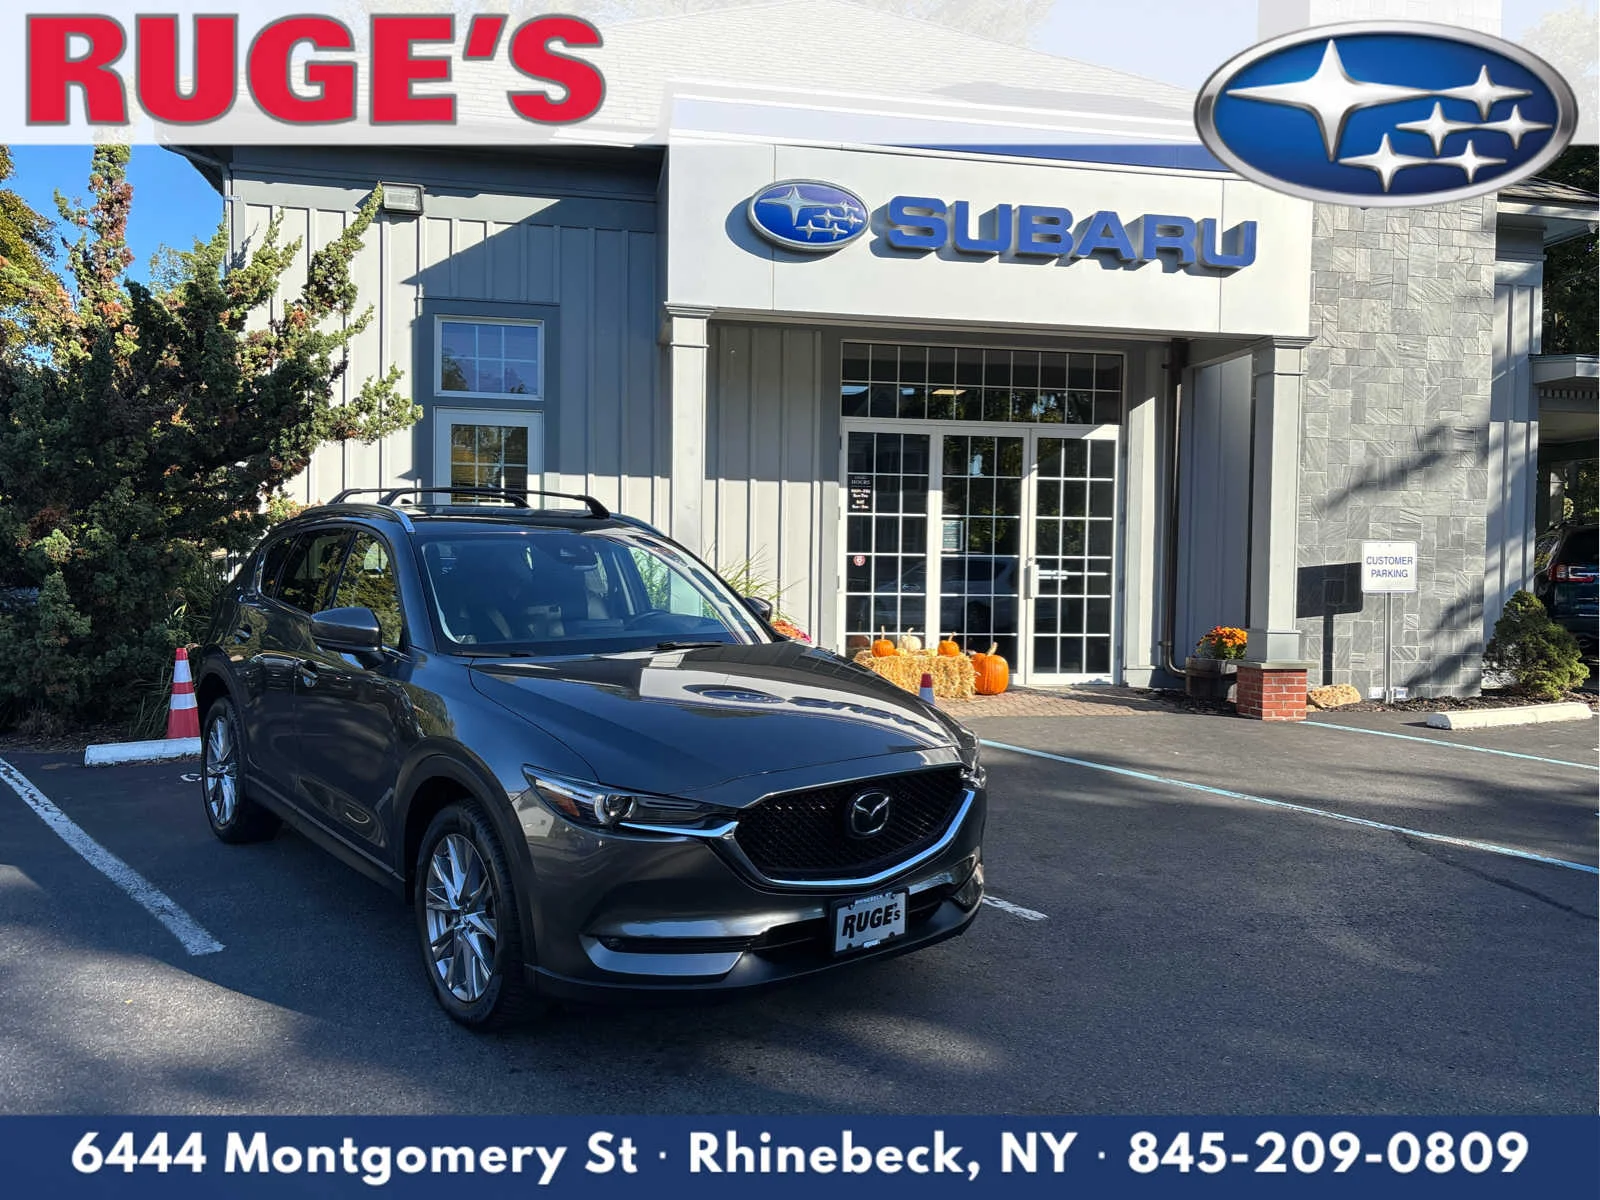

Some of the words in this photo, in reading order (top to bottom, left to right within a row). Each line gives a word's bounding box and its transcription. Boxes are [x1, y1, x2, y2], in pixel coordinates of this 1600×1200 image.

[887, 195, 1258, 268] SUBARU
[1366, 556, 1413, 565] CUSTOMER
[1371, 569, 1408, 578] PARKING
